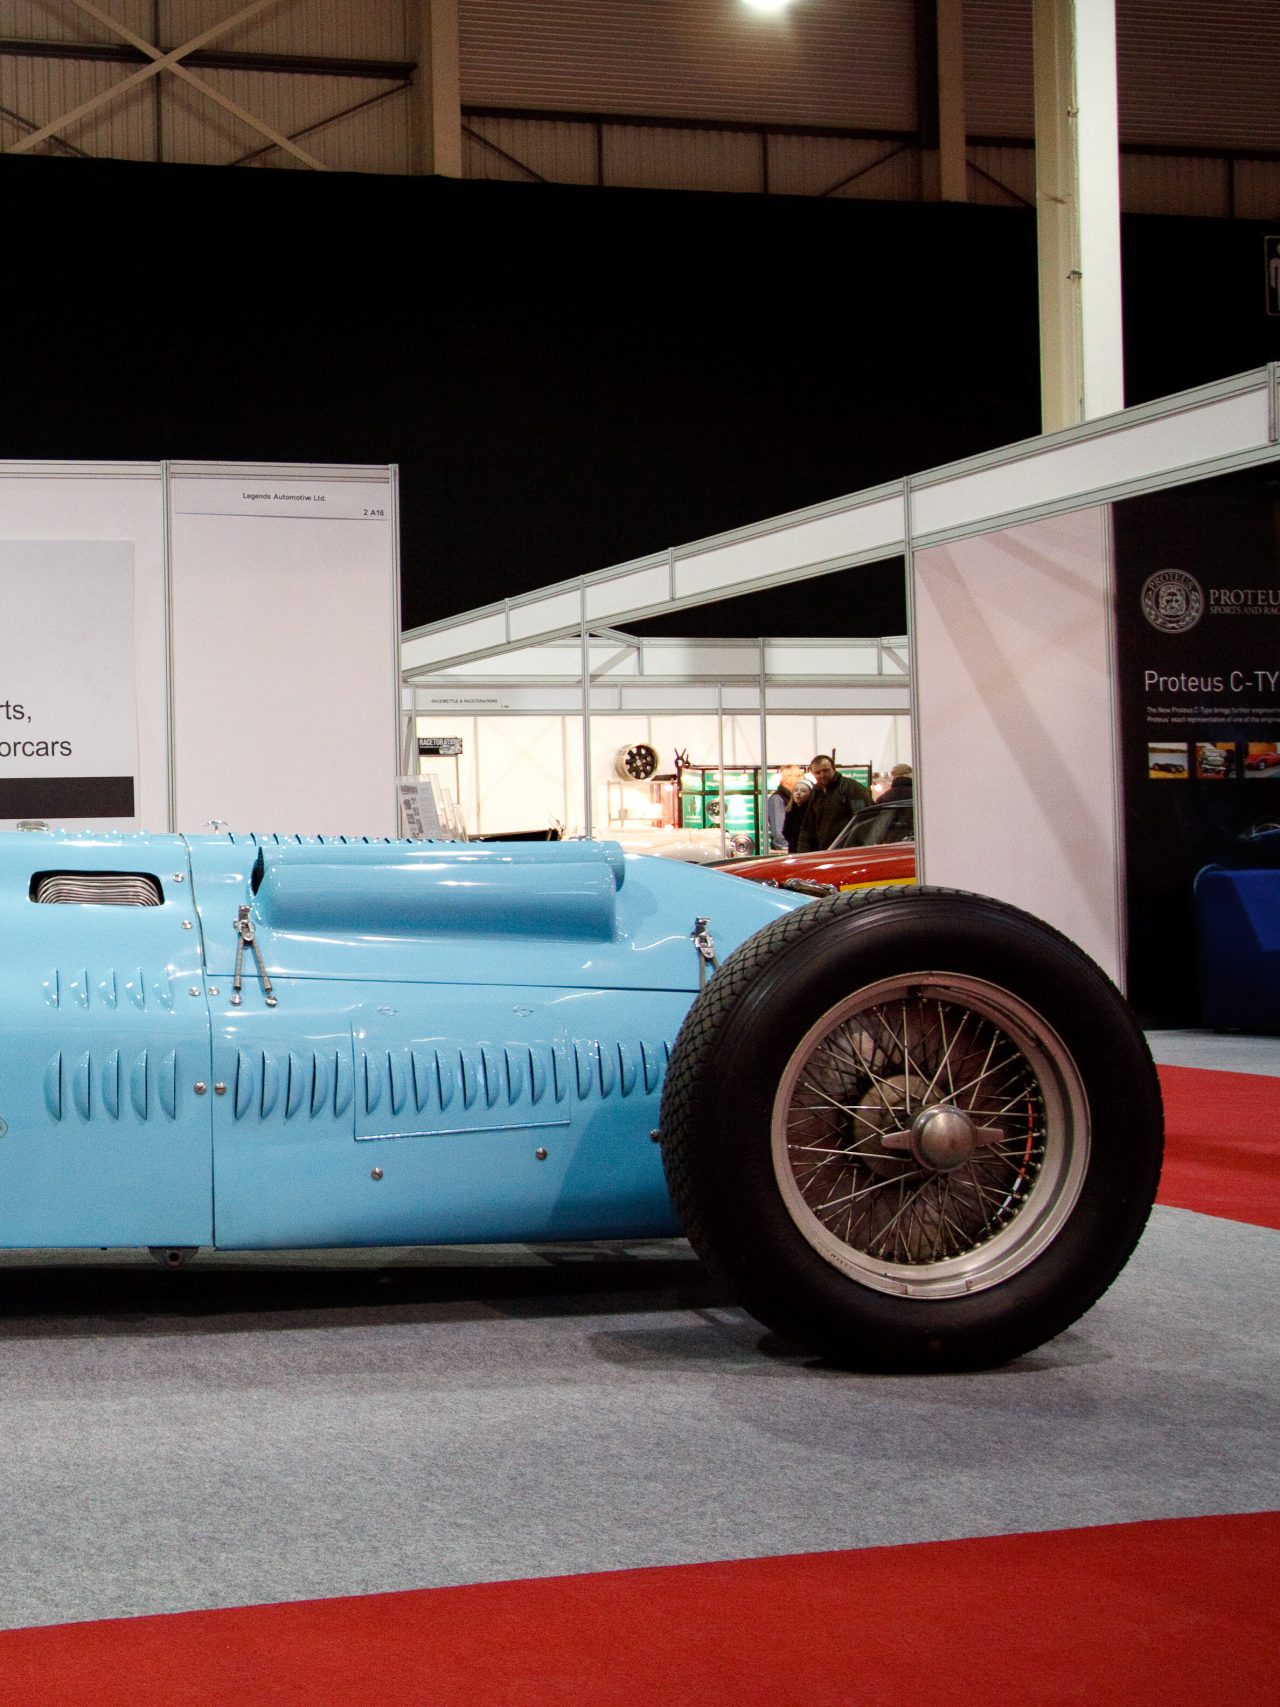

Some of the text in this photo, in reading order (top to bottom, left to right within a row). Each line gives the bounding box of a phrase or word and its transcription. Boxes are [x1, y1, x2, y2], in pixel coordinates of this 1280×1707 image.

[242, 492, 327, 502] Legends Automotive Ltd.
[370, 509, 385, 517] A16
[1148, 572, 1195, 592] PROTEUS
[1209, 606, 1243, 615] SPORTS
[1243, 606, 1263, 615] AND
[1144, 670, 1280, 693] Proteus C-TY
